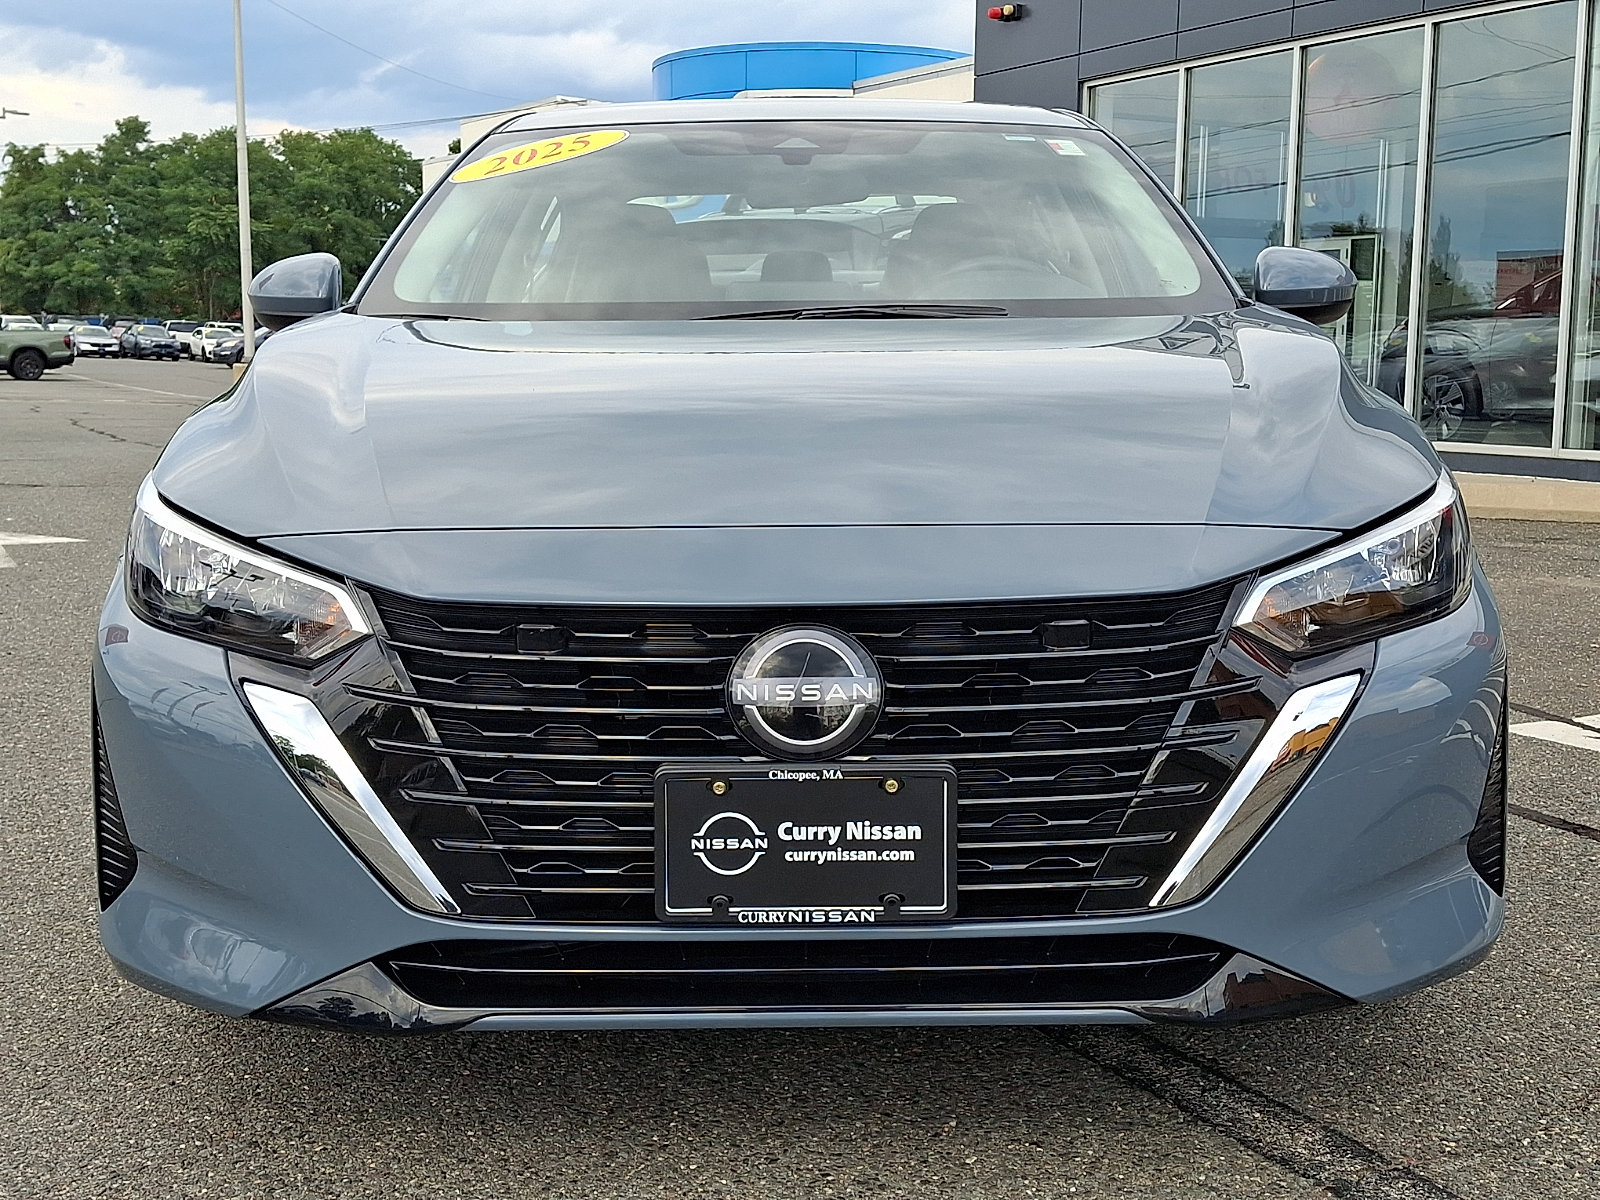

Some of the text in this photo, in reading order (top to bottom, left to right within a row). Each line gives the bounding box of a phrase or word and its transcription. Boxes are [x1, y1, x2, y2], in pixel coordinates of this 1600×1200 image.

[484, 134, 592, 175] 2025
[736, 682, 874, 701] NISSAN
[768, 767, 844, 781] Chicopee, MA
[777, 820, 922, 845] Curry Nissan
[691, 837, 768, 850] NISSAN
[784, 847, 915, 864] currynissan.com
